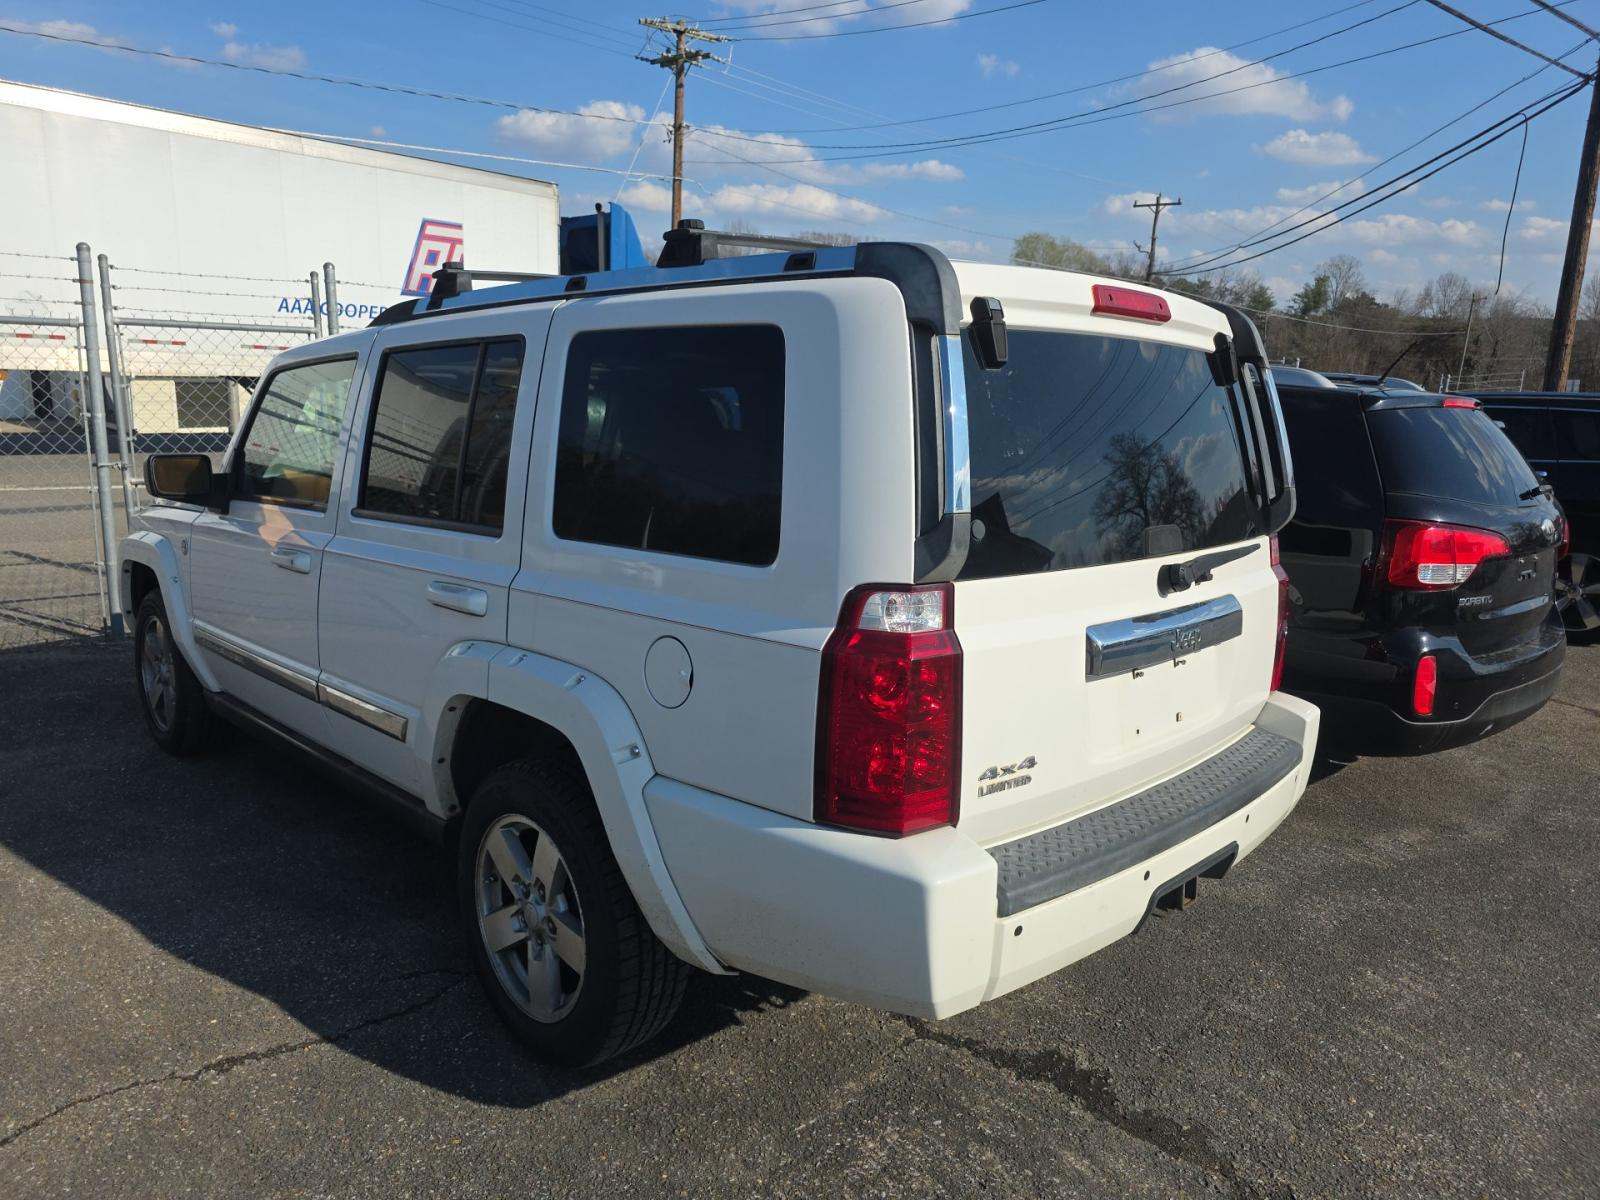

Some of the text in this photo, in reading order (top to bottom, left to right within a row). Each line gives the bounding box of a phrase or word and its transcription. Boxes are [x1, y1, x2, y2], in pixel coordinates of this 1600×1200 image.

[278, 297, 314, 315] AAA
[1170, 628, 1202, 651] Jeep
[978, 755, 1037, 781] 4x4
[977, 774, 1032, 797] LIMITED
